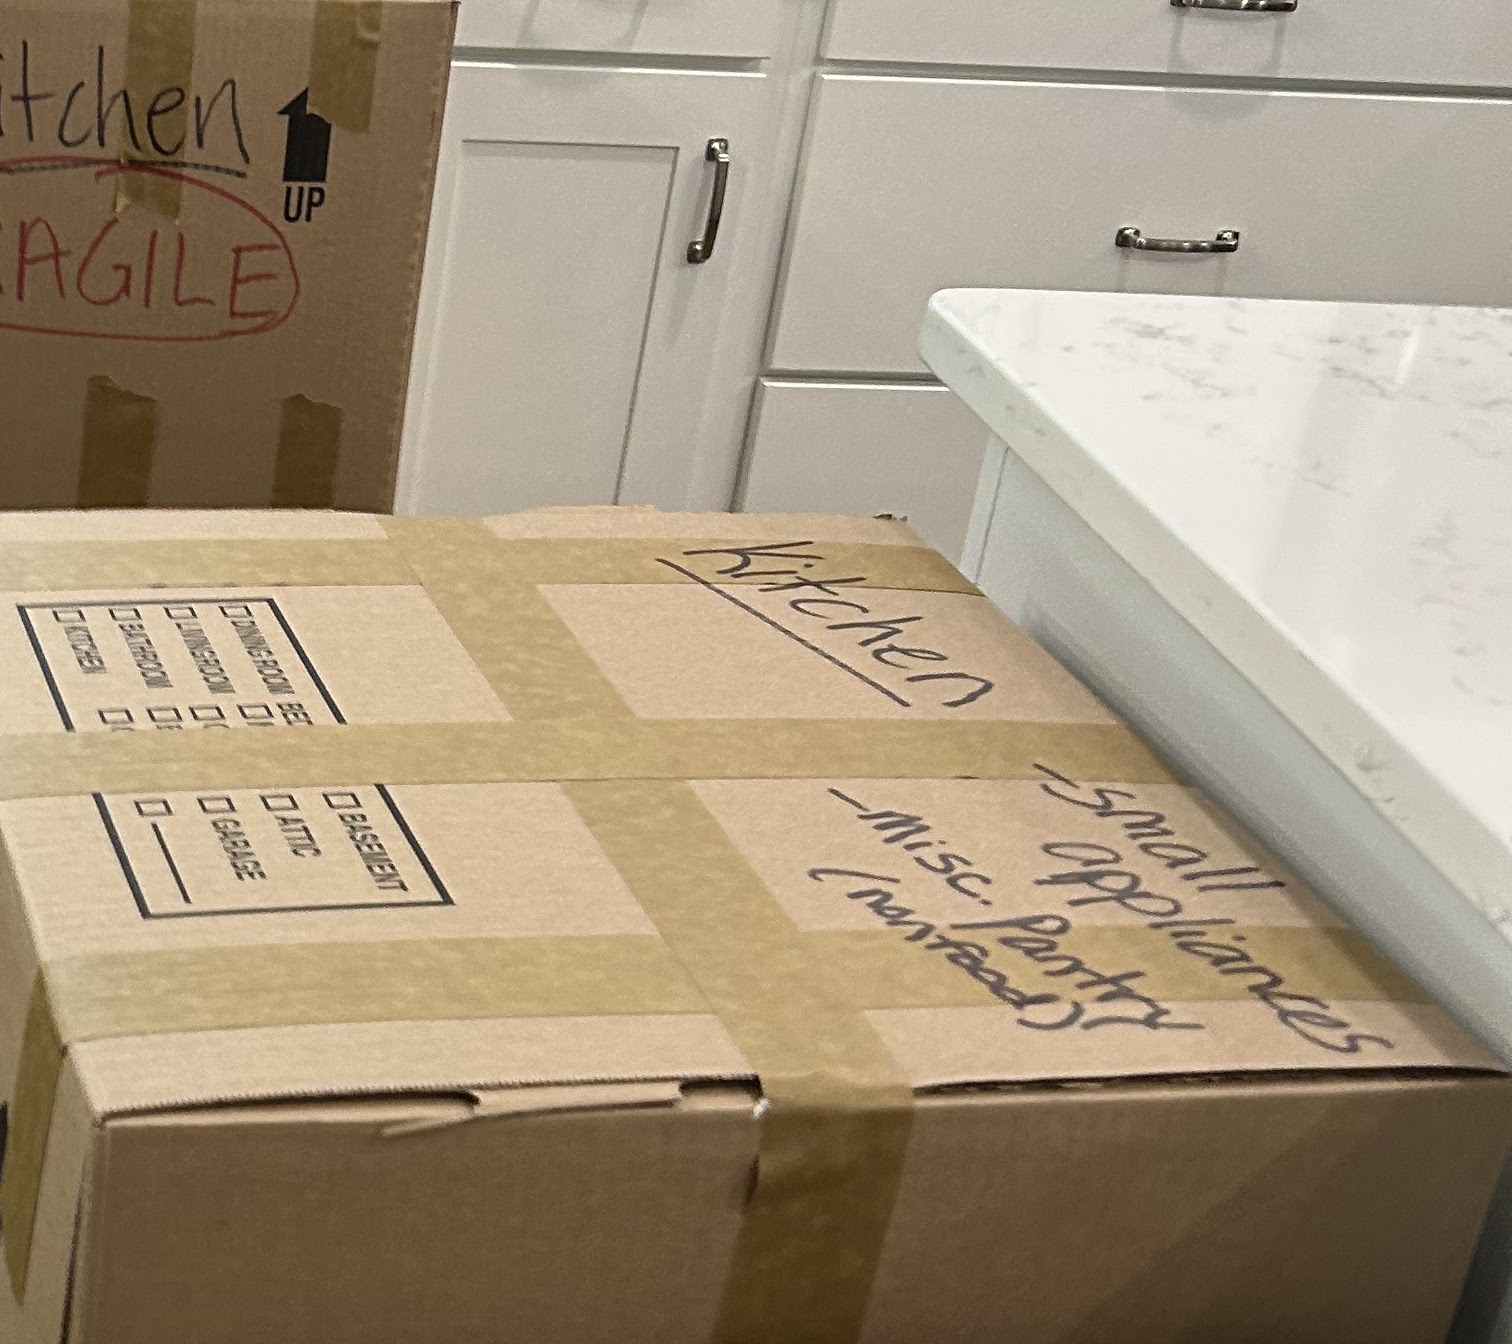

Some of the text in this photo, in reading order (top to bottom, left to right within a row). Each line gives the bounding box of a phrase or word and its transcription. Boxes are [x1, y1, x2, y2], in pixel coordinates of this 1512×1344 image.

[282, 186, 326, 223] UP
[681, 540, 996, 708] Kitchen
[210, 818, 267, 882] GARAGE
[275, 815, 322, 857] ATTIC
[338, 813, 409, 893] BASEMENT
[1033, 841, 1395, 1055] appliances
